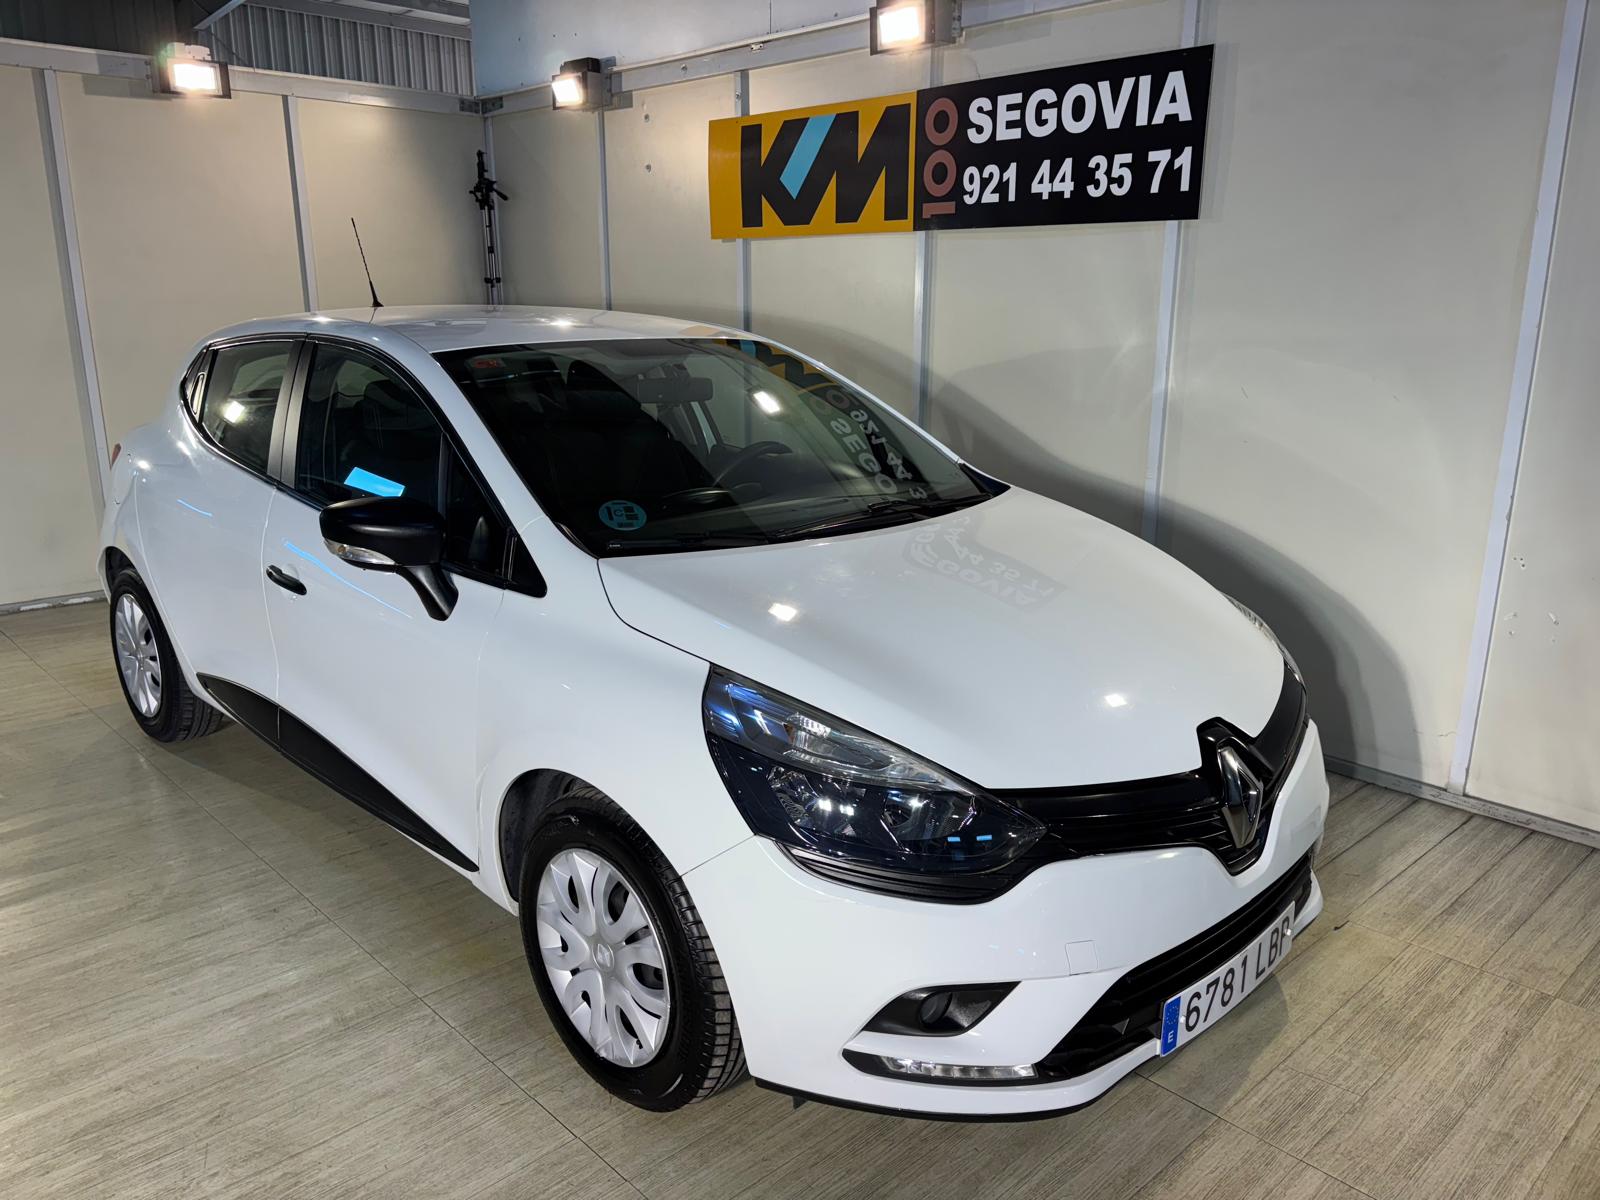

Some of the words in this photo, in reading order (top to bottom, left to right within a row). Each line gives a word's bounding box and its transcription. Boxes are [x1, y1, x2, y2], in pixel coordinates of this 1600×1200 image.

[967, 71, 1192, 144] SEGOVIA
[740, 103, 911, 227] KM
[922, 97, 959, 218] 100
[963, 162, 1018, 204] 921
[1031, 157, 1074, 199] 44
[1087, 153, 1132, 197] 35
[1147, 146, 1192, 194] 71
[1185, 954, 1248, 1032] 6781
[1167, 1030, 1174, 1043] E
